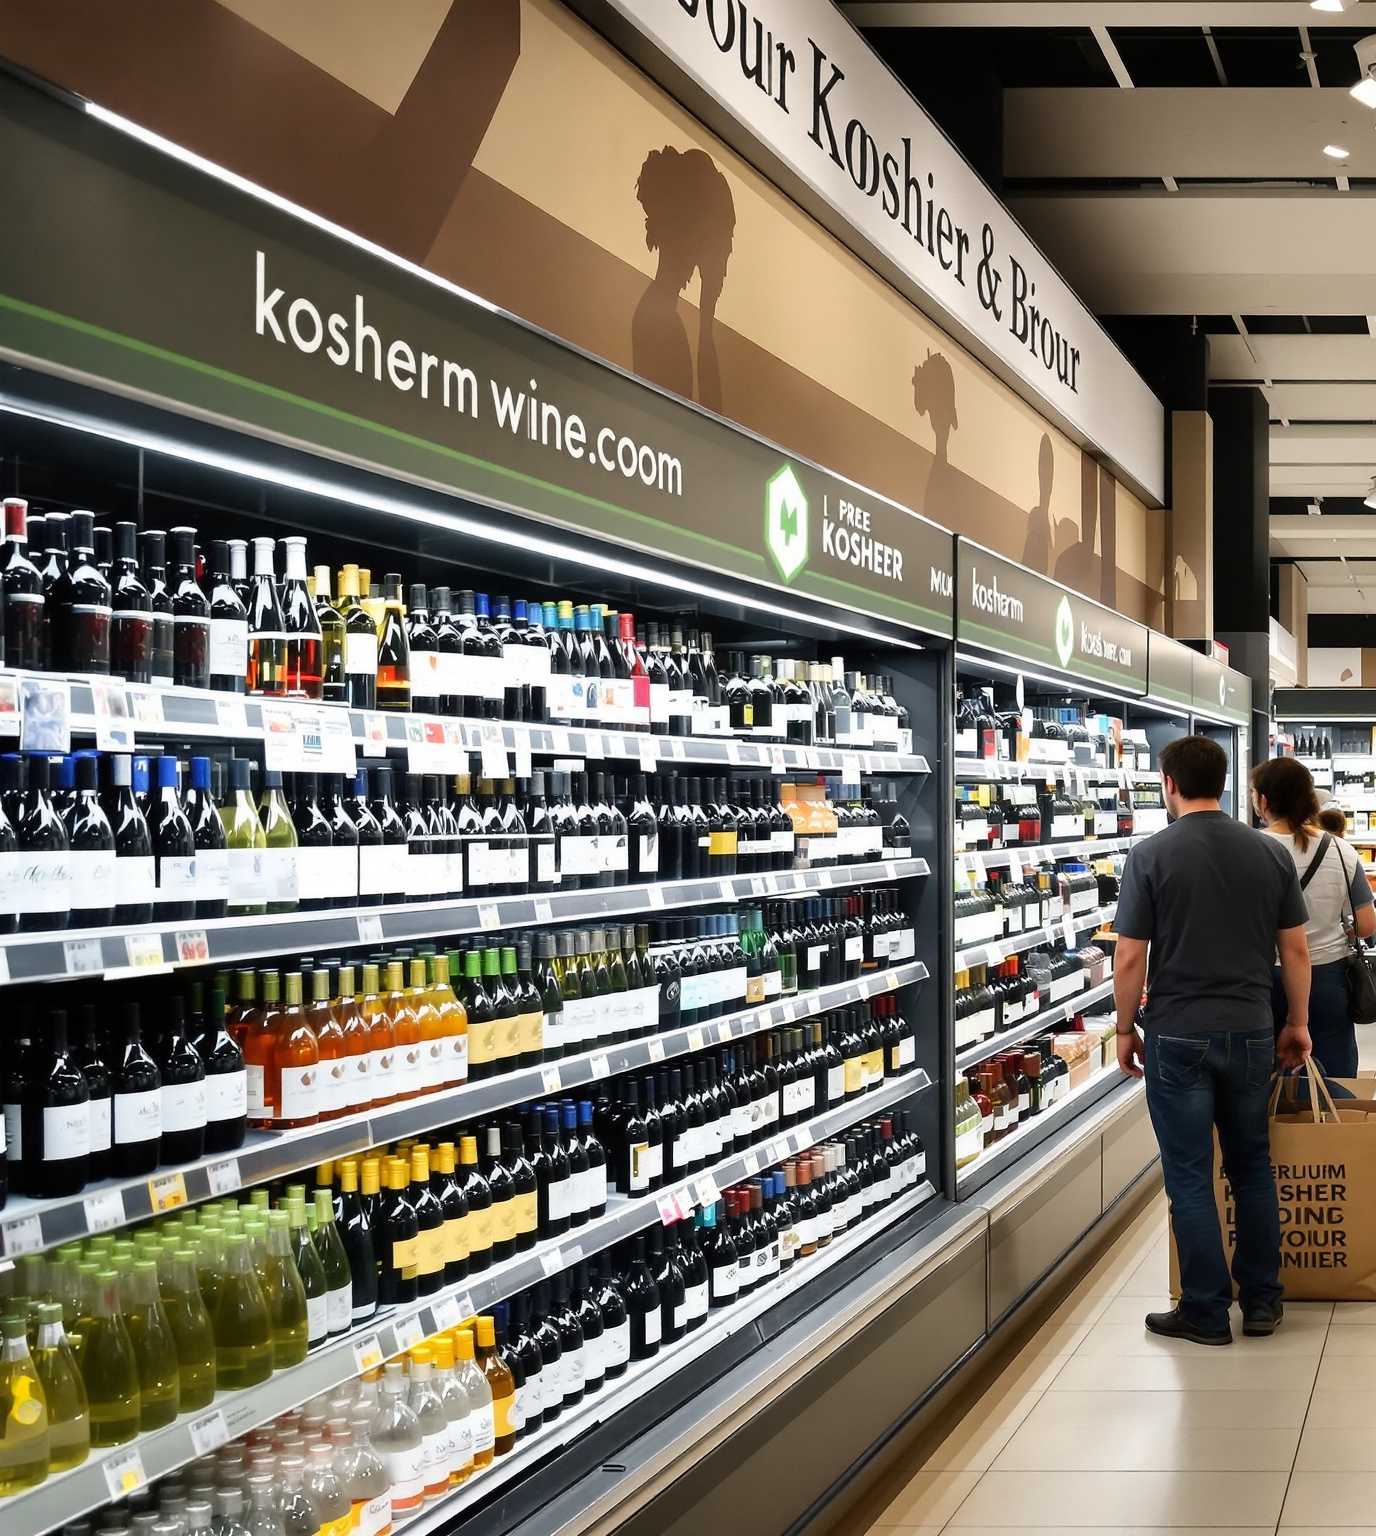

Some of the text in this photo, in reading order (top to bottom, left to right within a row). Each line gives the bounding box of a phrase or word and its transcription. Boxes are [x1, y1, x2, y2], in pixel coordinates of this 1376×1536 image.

[976, 223, 1002, 322] &
[255, 250, 683, 496] kosherm wine.coom
[822, 518, 903, 582] KOSHEER
[839, 498, 871, 533] PREE
